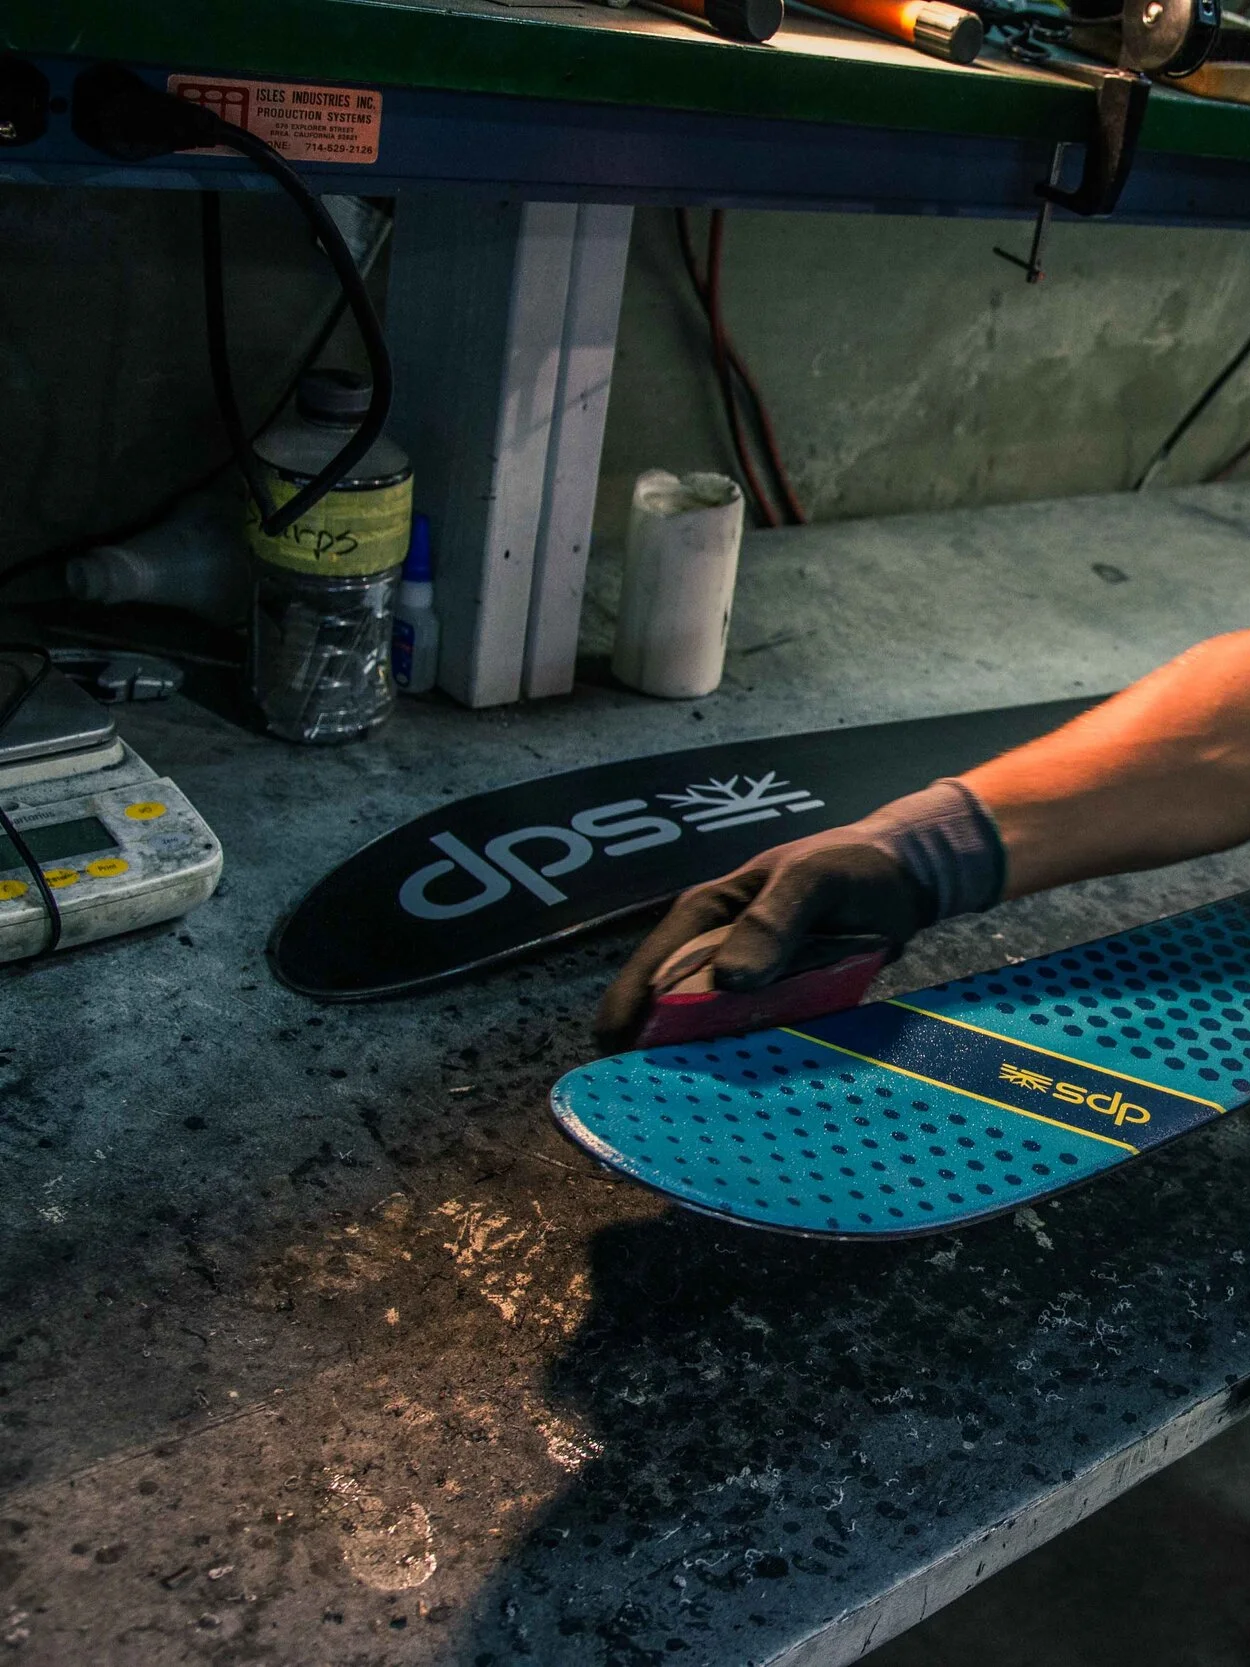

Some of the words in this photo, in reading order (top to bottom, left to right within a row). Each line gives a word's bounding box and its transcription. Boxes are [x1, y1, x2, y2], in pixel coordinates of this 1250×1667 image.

[256, 88, 285, 103] ISLES
[292, 91, 350, 108] INDUSTRIES
[356, 95, 376, 110] INC.
[257, 107, 322, 120] PRODUCTION
[327, 112, 372, 125] SYSTEMS
[291, 123, 327, 132] EXPLORER
[329, 126, 355, 134] STREET
[293, 131, 335, 140] CALIFORNIA
[267, 140, 291, 151] ONE:
[12, 811, 56, 825] artorius
[399, 799, 682, 920] dps
